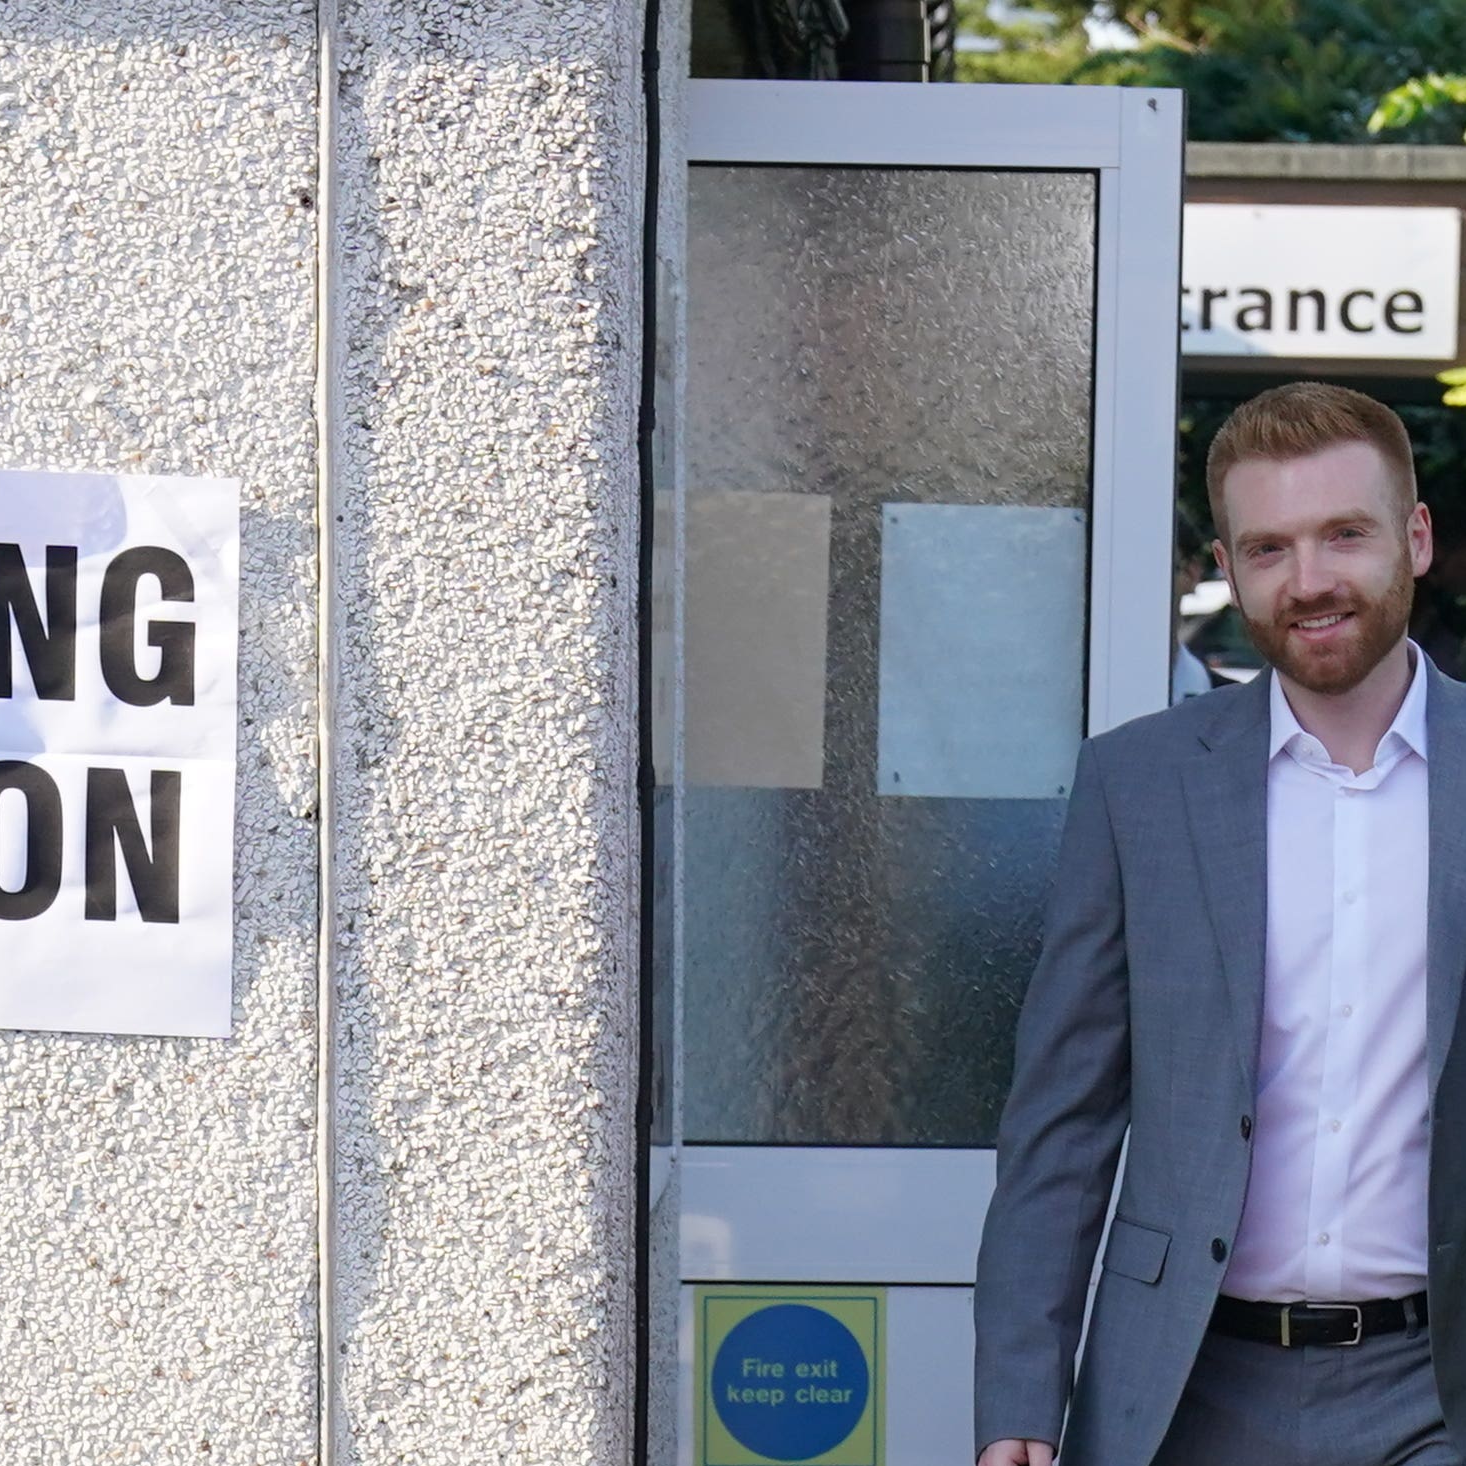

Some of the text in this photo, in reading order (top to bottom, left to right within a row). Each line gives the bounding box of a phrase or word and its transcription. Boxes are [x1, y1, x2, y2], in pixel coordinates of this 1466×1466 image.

[742, 1358, 838, 1378] Fire exit
[727, 1384, 853, 1407] keep clear
